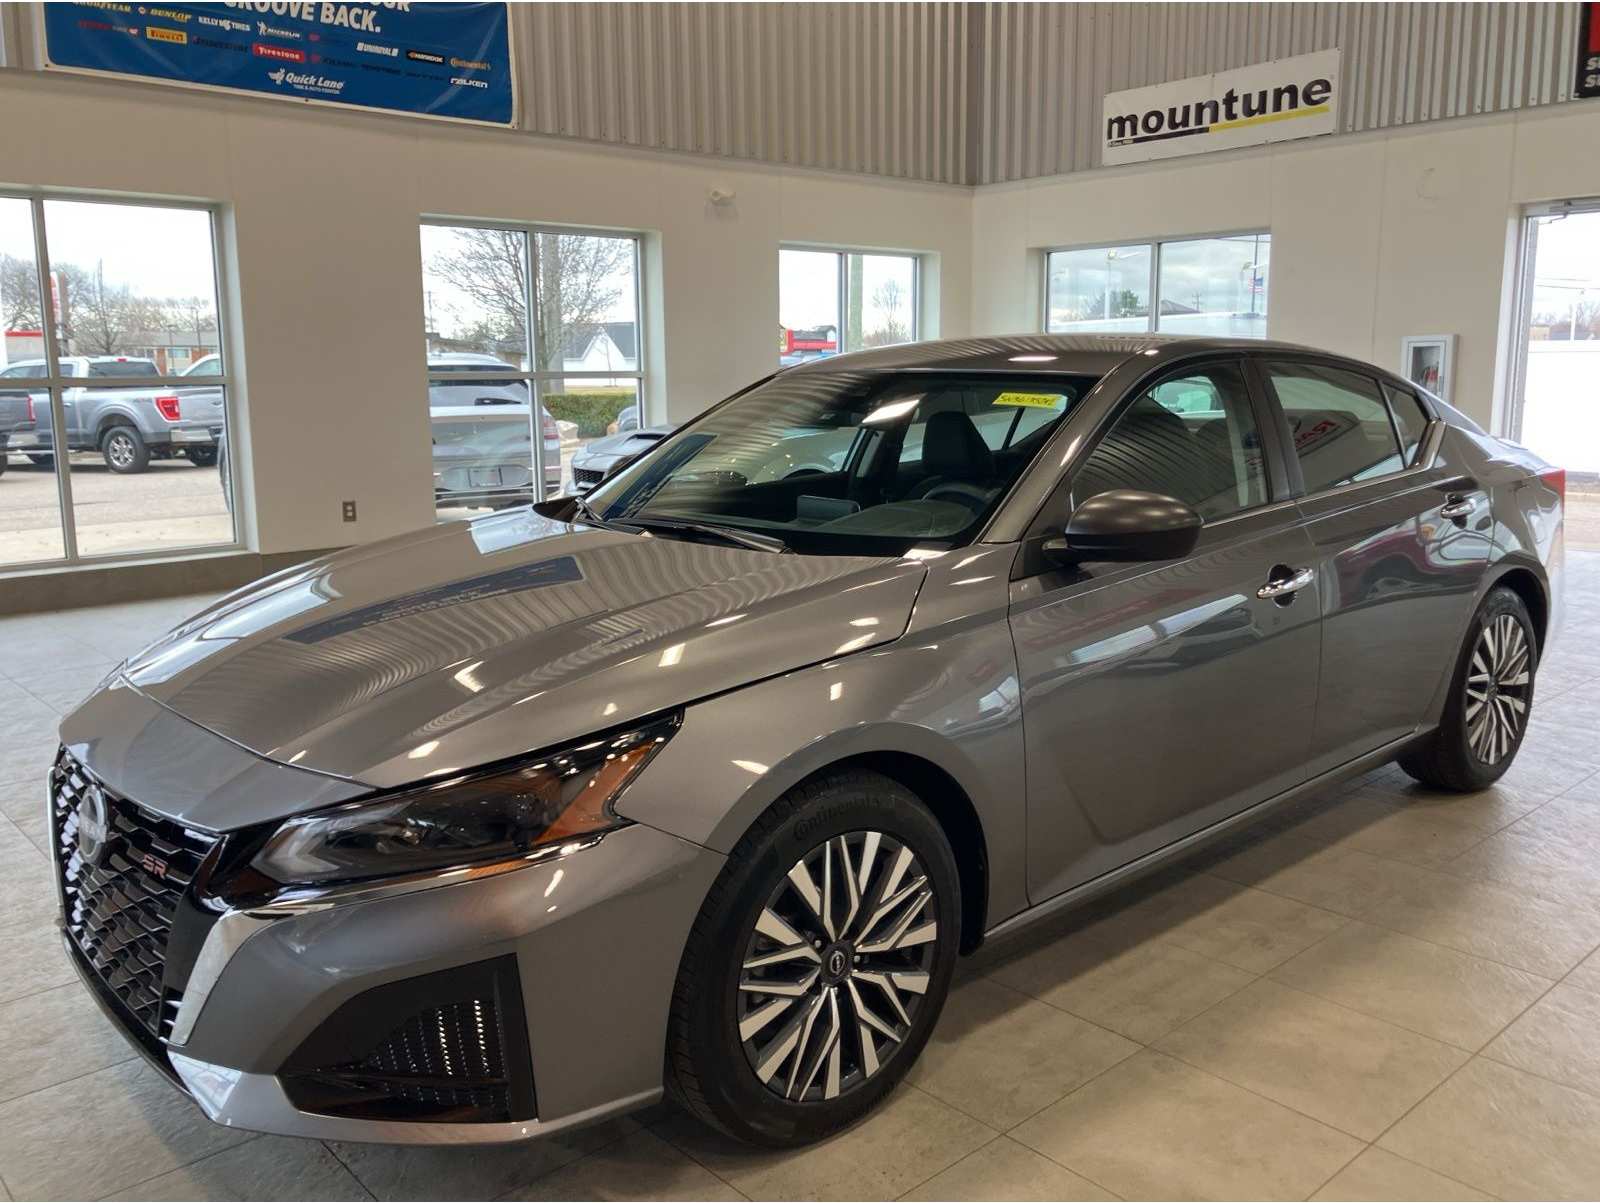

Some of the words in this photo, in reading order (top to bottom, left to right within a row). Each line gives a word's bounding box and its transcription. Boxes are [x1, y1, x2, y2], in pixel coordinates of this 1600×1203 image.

[150, 9, 192, 22] DUNLOP
[199, 16, 218, 26] KELLY
[320, 3, 381, 33] BACK.
[258, 46, 300, 60] Firestone
[285, 72, 317, 85] Quick
[317, 77, 344, 89] Lane
[1107, 78, 1332, 140] mountune
[143, 853, 166, 880] SR
